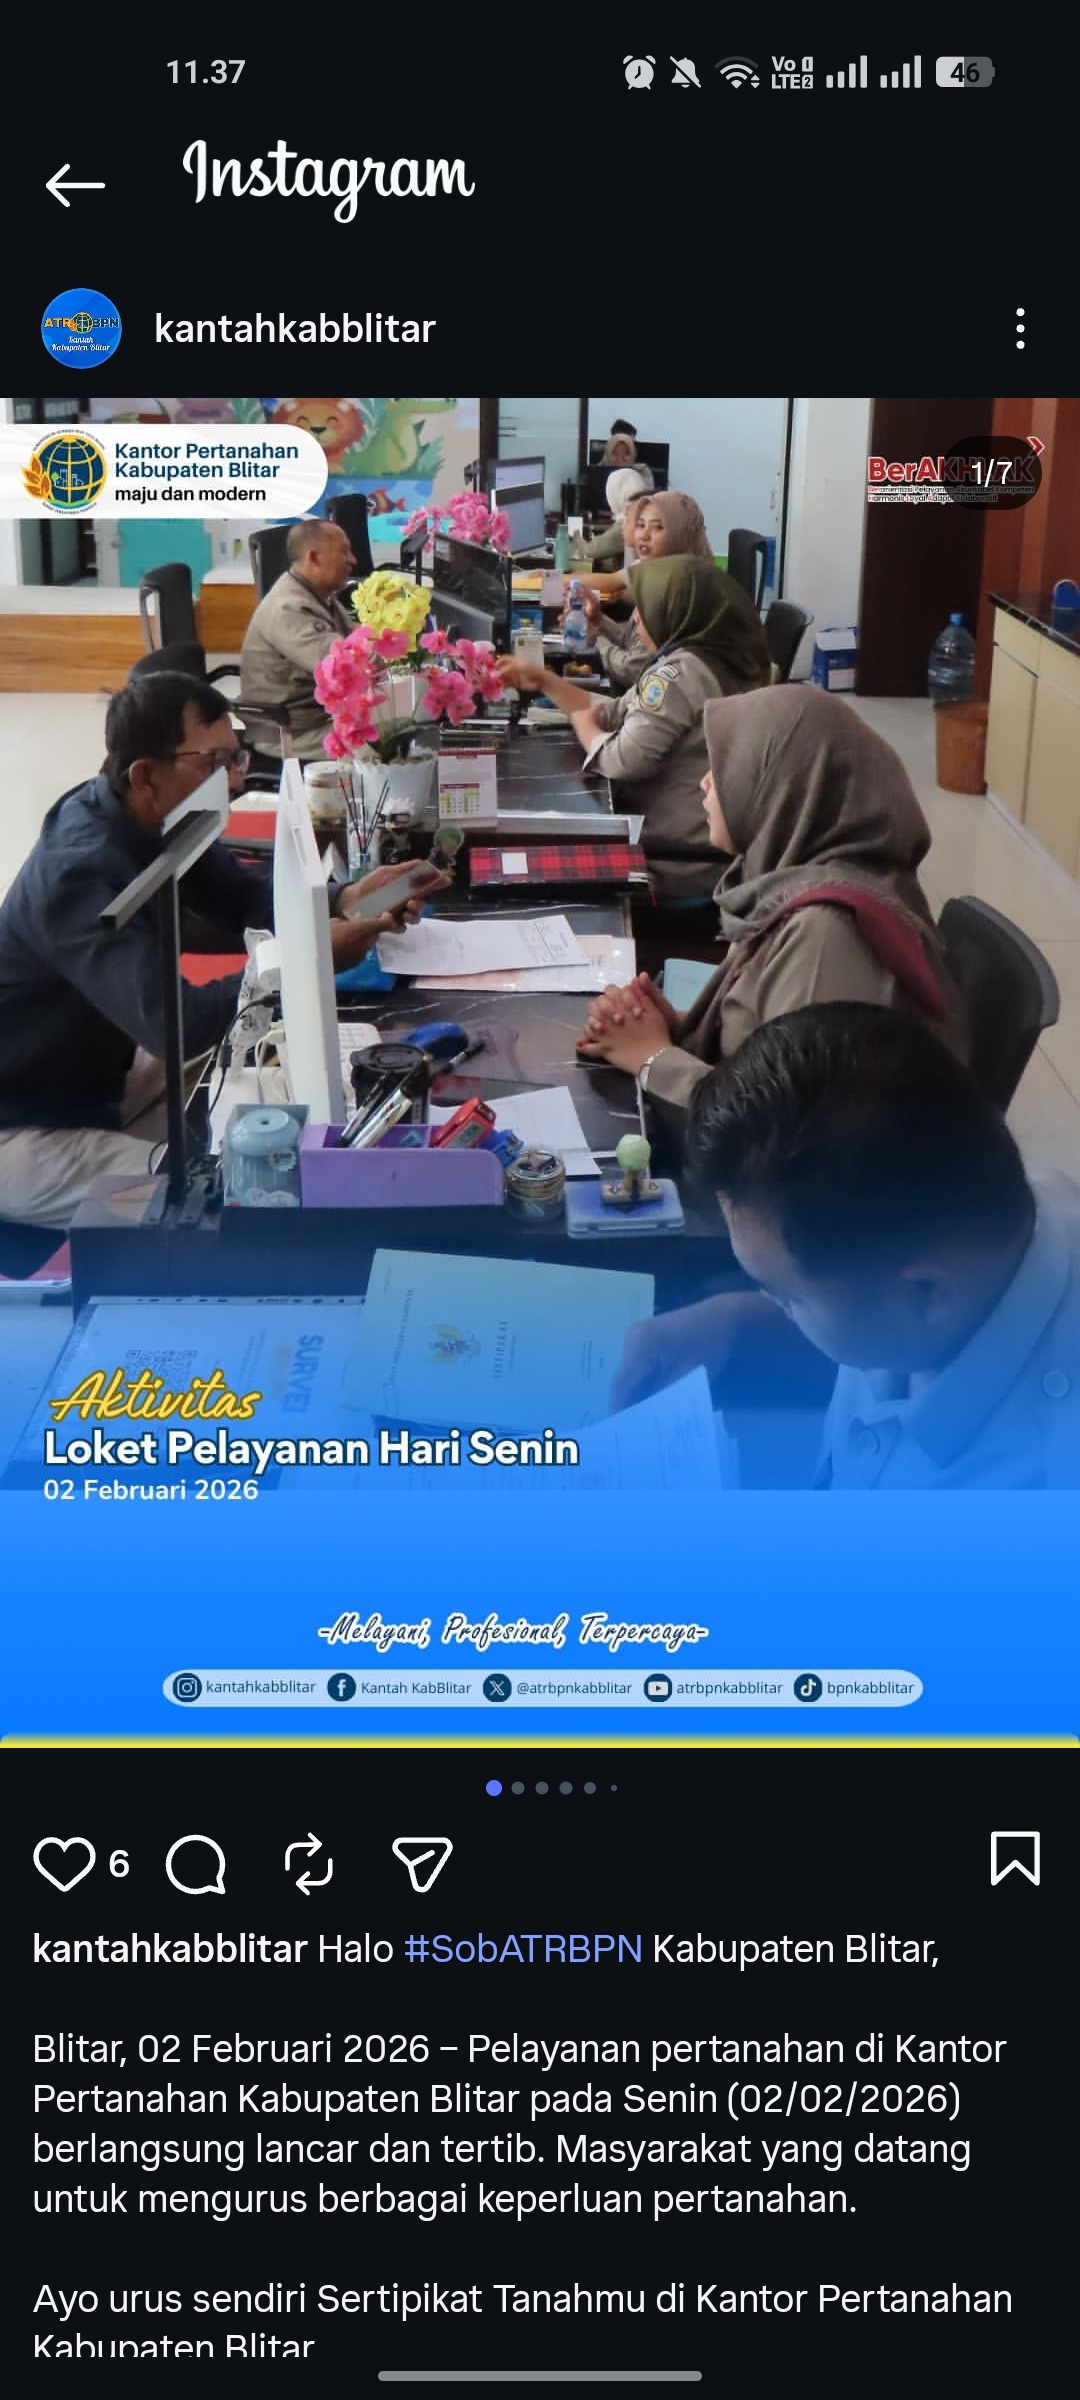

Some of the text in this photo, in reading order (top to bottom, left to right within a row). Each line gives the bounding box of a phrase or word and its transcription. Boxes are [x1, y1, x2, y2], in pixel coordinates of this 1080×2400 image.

[166, 59, 246, 85] 11.37
[771, 55, 797, 72] Vo
[950, 61, 980, 83] 46
[182, 139, 476, 224] Instagram
[155, 312, 437, 343] kantahkabblitar
[971, 458, 1013, 488] 1/7
[282, 1334, 325, 1413] SURVEI
[108, 1849, 130, 1878] 6
[33, 1932, 939, 1972] kantahkabblitar Halo #SobATRBPN Kabupaten Blitar,
[34, 2032, 127, 2068] Blitar,
[138, 2034, 181, 2063] 02
[193, 2032, 332, 2063] Februari
[343, 2034, 430, 2063] 2026
[469, 2032, 640, 2072] Pelayanan
[652, 2032, 844, 2072] pertanahan
[855, 2032, 884, 2063] di
[896, 2034, 1008, 2063] Kantor
[34, 2080, 960, 2122] Pertanahan Kabupaten Blitar pada Senin (02/02/2026)
[34, 2132, 971, 2172] berlangsung lancar dan tertib. Masyarakat yang datang
[33, 2182, 857, 2222] untuk mengurus berbagai keperluan pertanahan.
[32, 2282, 1012, 2322] Ayo urus sendiri Sertipikat Tanahmu di Kantor Pertanahan
